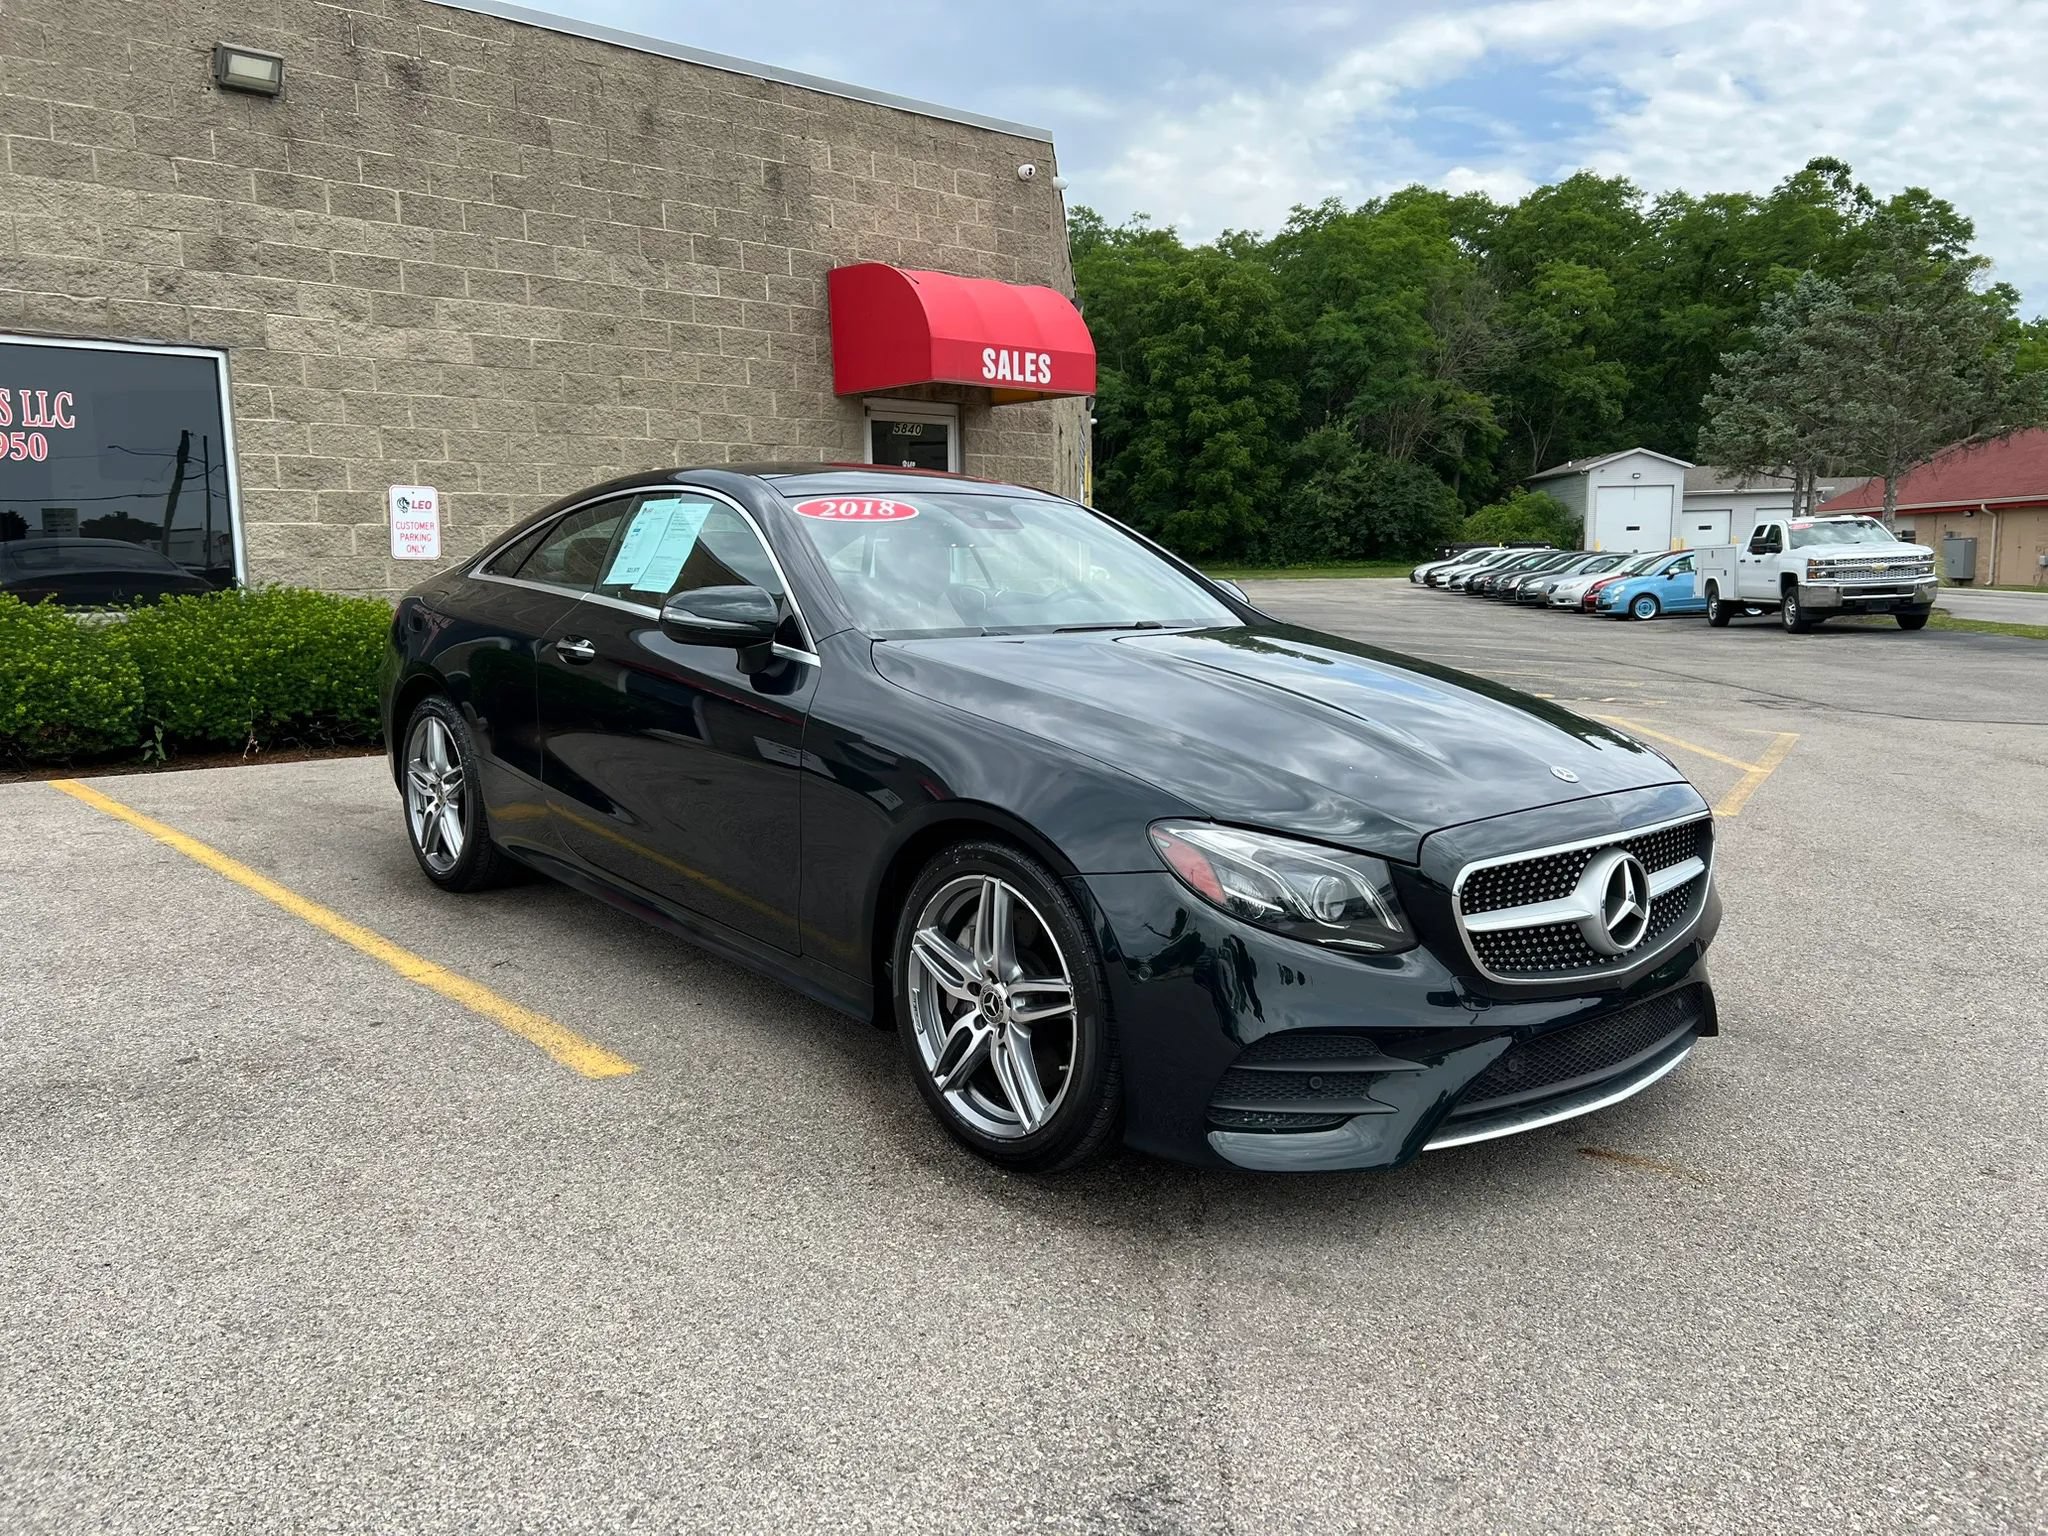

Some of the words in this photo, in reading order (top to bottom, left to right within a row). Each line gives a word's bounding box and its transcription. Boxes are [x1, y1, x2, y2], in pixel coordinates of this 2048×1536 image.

[982, 347, 1051, 384] SALES
[19, 389, 75, 429] LLC
[894, 423, 922, 435] 5840
[411, 500, 432, 509] LEO
[819, 501, 895, 516] 2018
[395, 521, 435, 530] CUSTOMER
[399, 533, 432, 542] PARKING
[406, 544, 426, 553] ONLY
